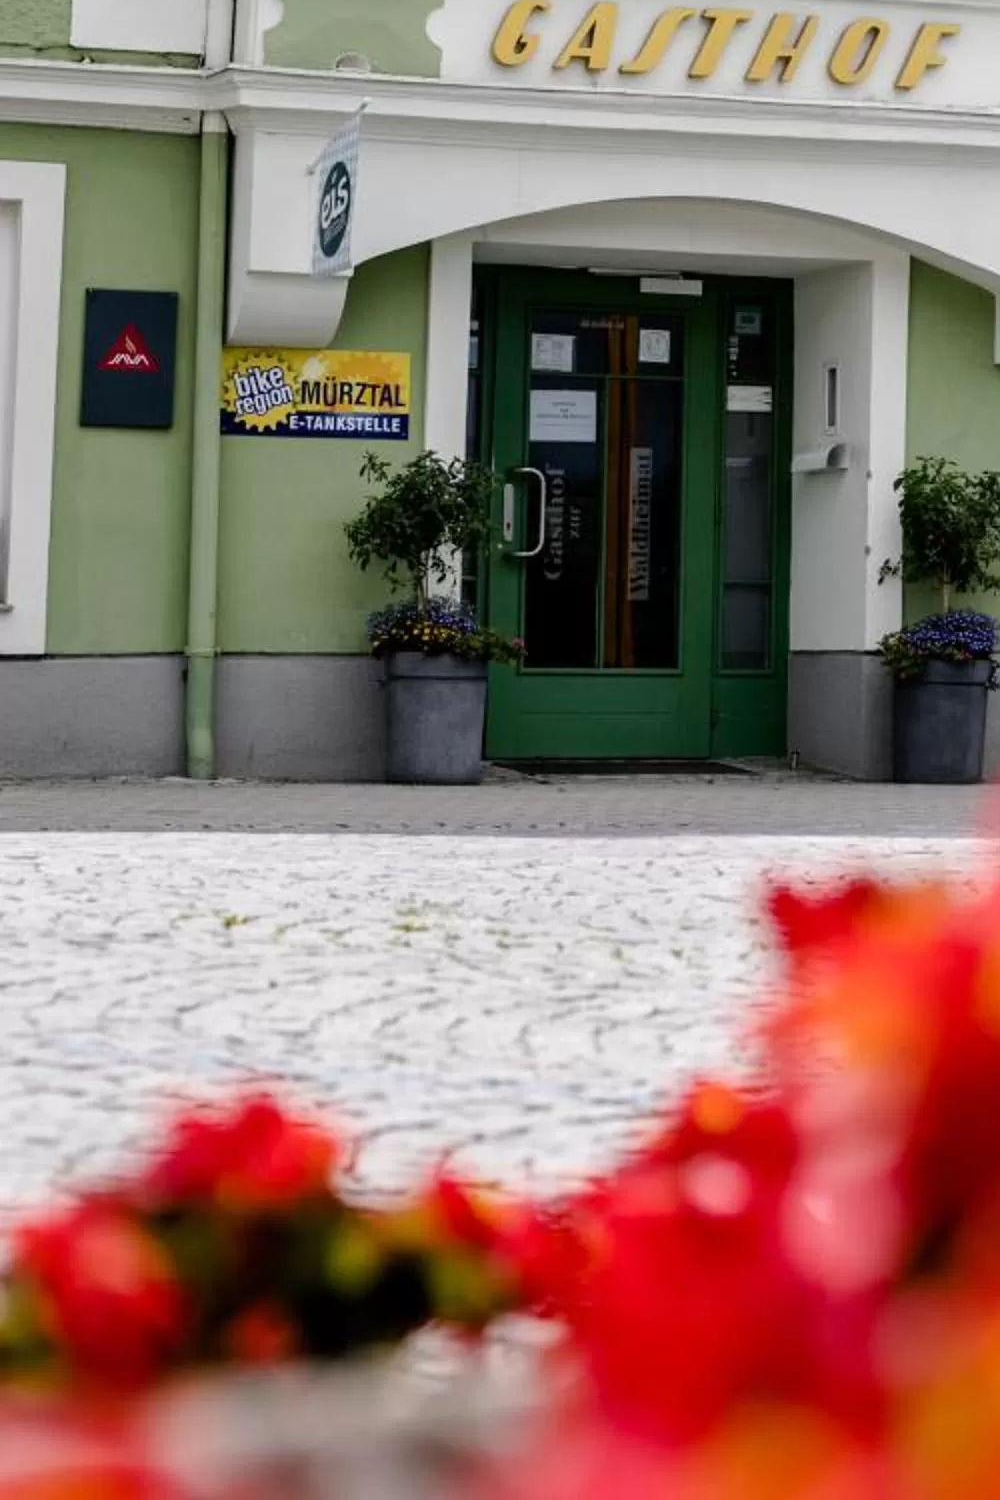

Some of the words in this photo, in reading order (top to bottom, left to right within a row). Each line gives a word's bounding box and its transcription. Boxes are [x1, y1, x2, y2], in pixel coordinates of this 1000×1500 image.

[234, 365, 284, 397] bike
[301, 377, 406, 407] MÜRZTAL
[235, 385, 293, 416] region
[289, 414, 401, 433] E-TANKSTELLE
[543, 461, 565, 580] Gasthof
